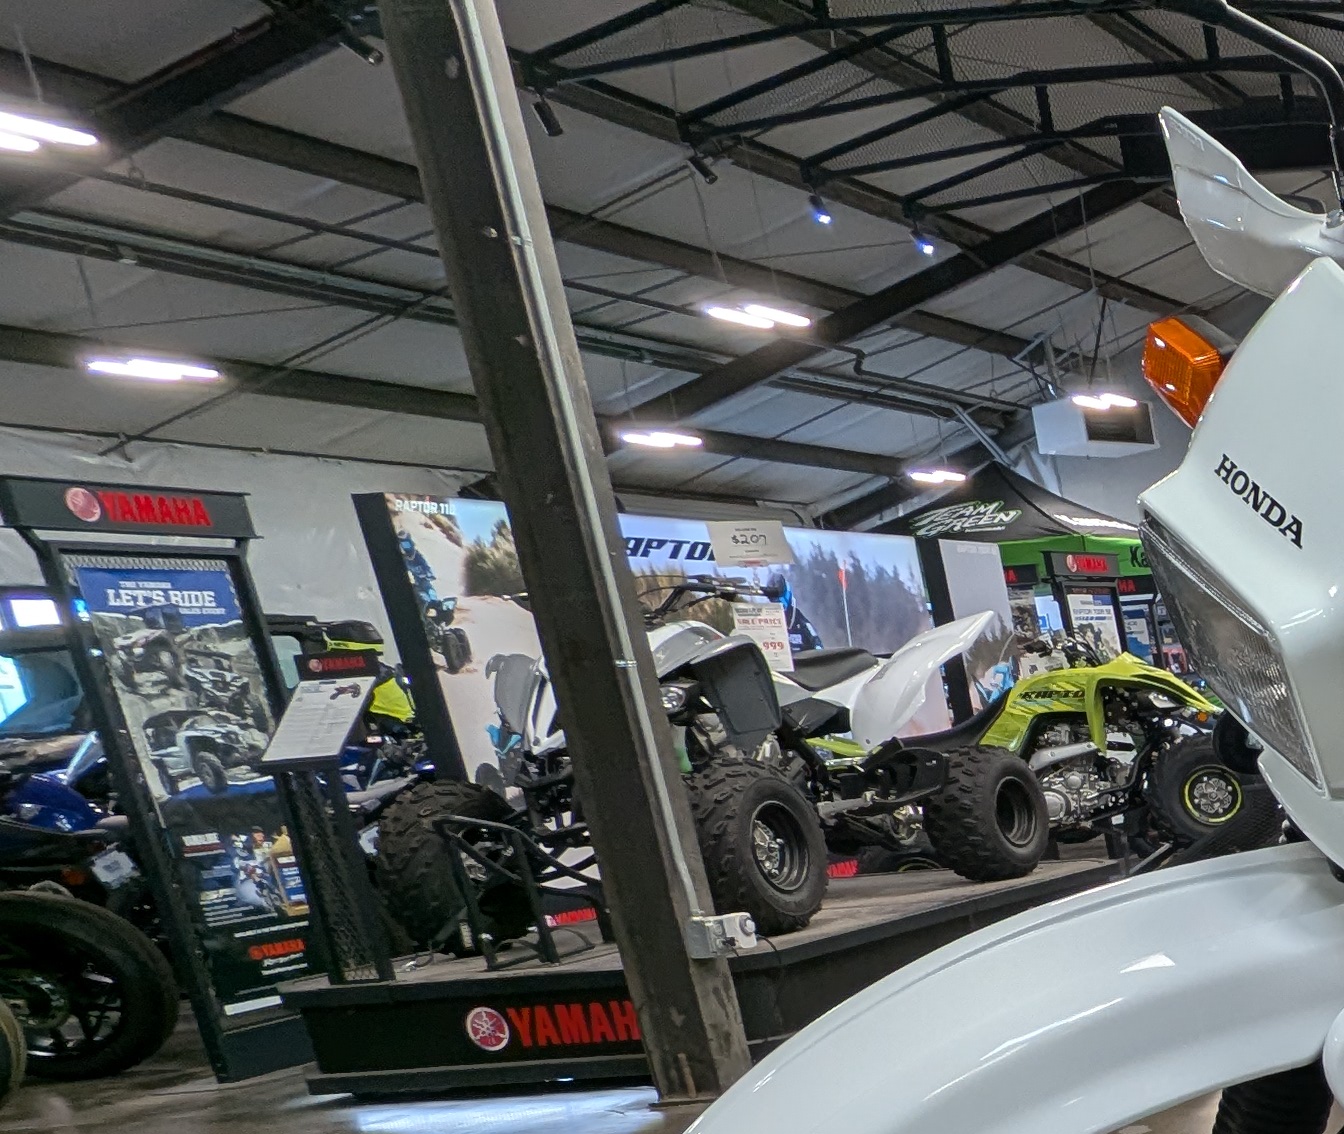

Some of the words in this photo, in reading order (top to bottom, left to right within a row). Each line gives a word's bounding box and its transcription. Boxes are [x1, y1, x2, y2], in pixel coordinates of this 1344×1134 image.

[97, 490, 214, 527] YAMAHA
[395, 499, 438, 515] RAPTOR
[915, 502, 1001, 524] TEAM
[1214, 453, 1305, 550] HONDA
[916, 509, 1019, 536] GREEN
[624, 536, 716, 562] APTO
[106, 588, 166, 608] LET'S
[169, 590, 217, 609] RIDE
[506, 1000, 643, 1047] YAMAH
